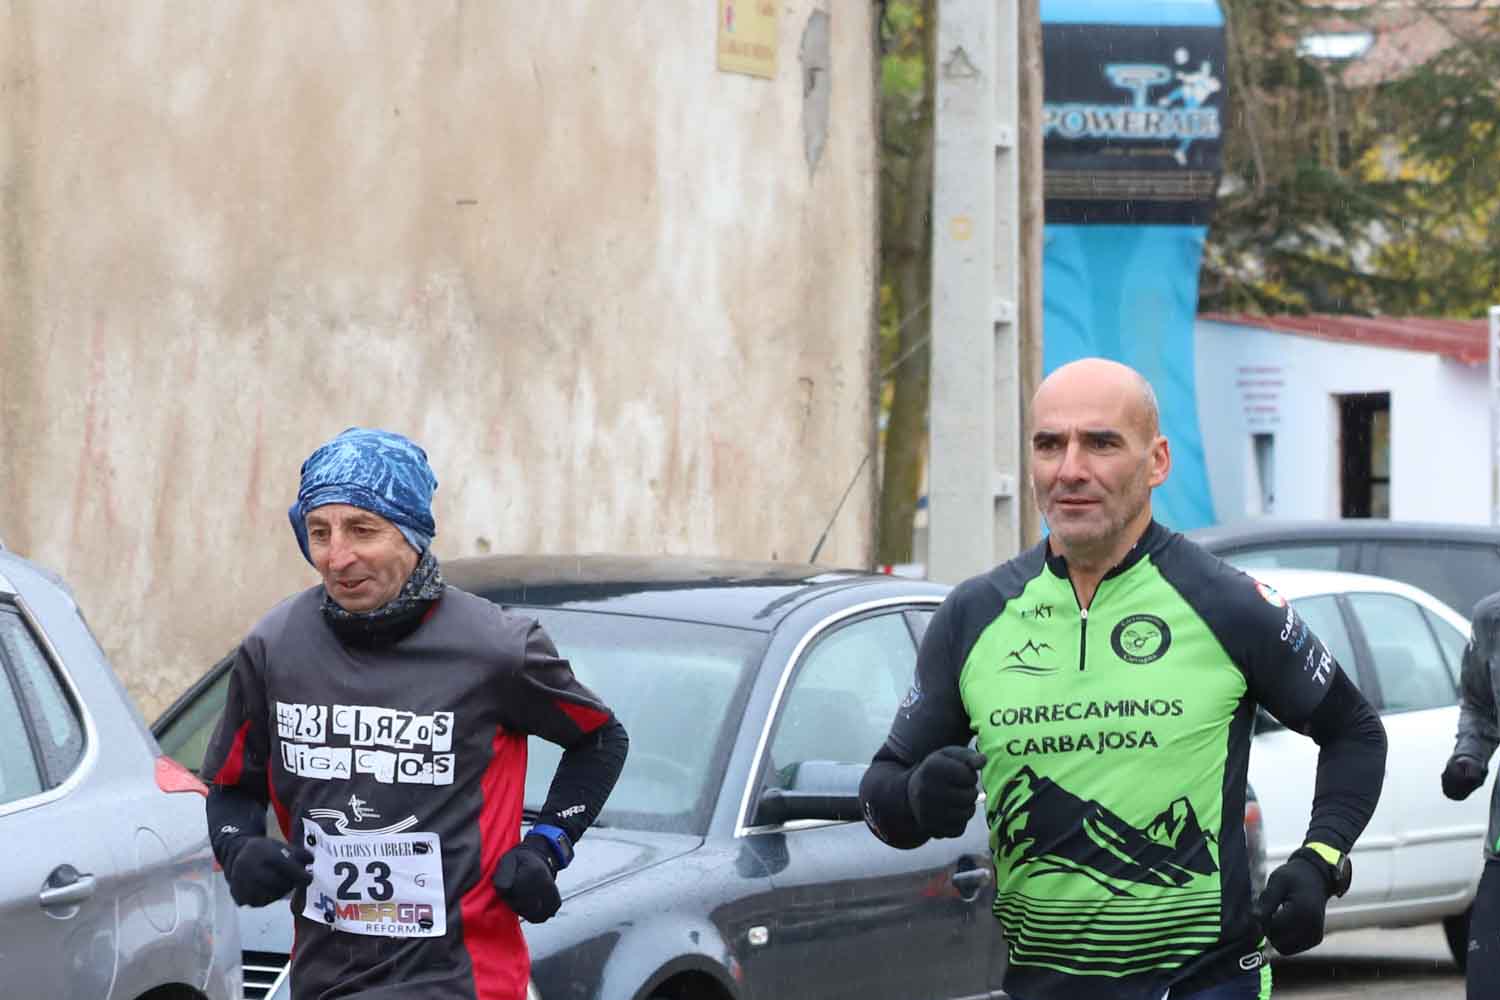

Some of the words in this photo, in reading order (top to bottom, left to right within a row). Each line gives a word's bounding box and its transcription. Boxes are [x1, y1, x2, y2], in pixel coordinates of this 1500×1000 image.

[989, 699, 1184, 727] CORRECAMINOS
[1006, 731, 1158, 757] CARBAJOSA
[341, 843, 371, 857] CROSS
[334, 861, 394, 900] 23
[366, 923, 433, 934] REFORMAS
